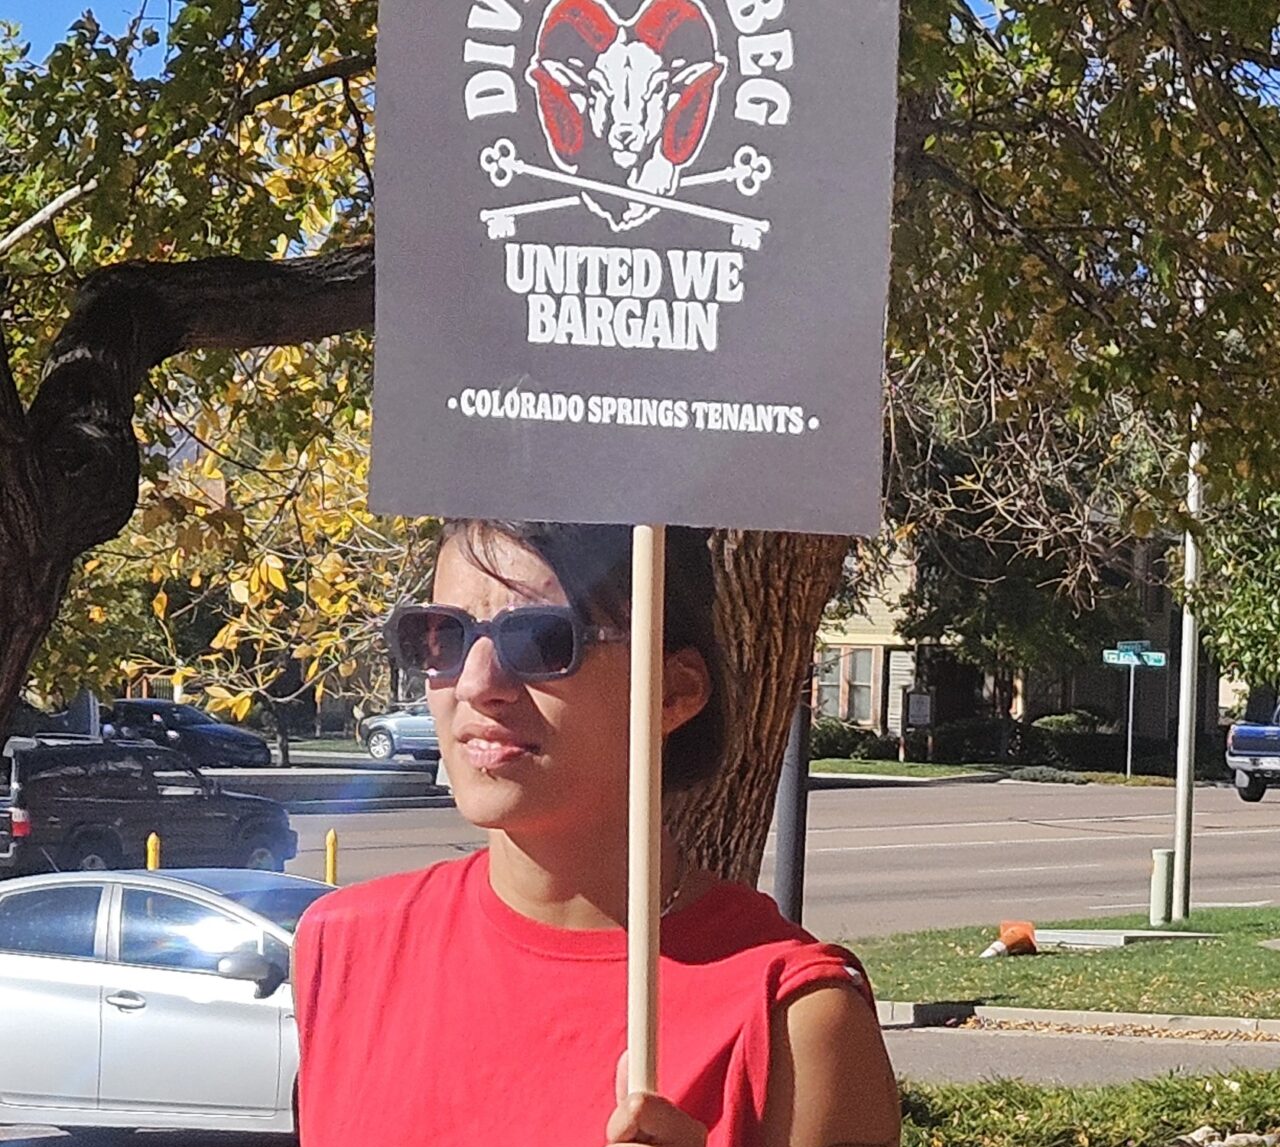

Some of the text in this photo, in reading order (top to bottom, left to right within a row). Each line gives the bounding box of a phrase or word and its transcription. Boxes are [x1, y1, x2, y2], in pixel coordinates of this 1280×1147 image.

[729, 0, 793, 126] BEG
[504, 243, 744, 302] UNITED WE
[527, 294, 718, 352] BARGAIN
[459, 387, 805, 434] COLORADO SPRINGS TENANTS
